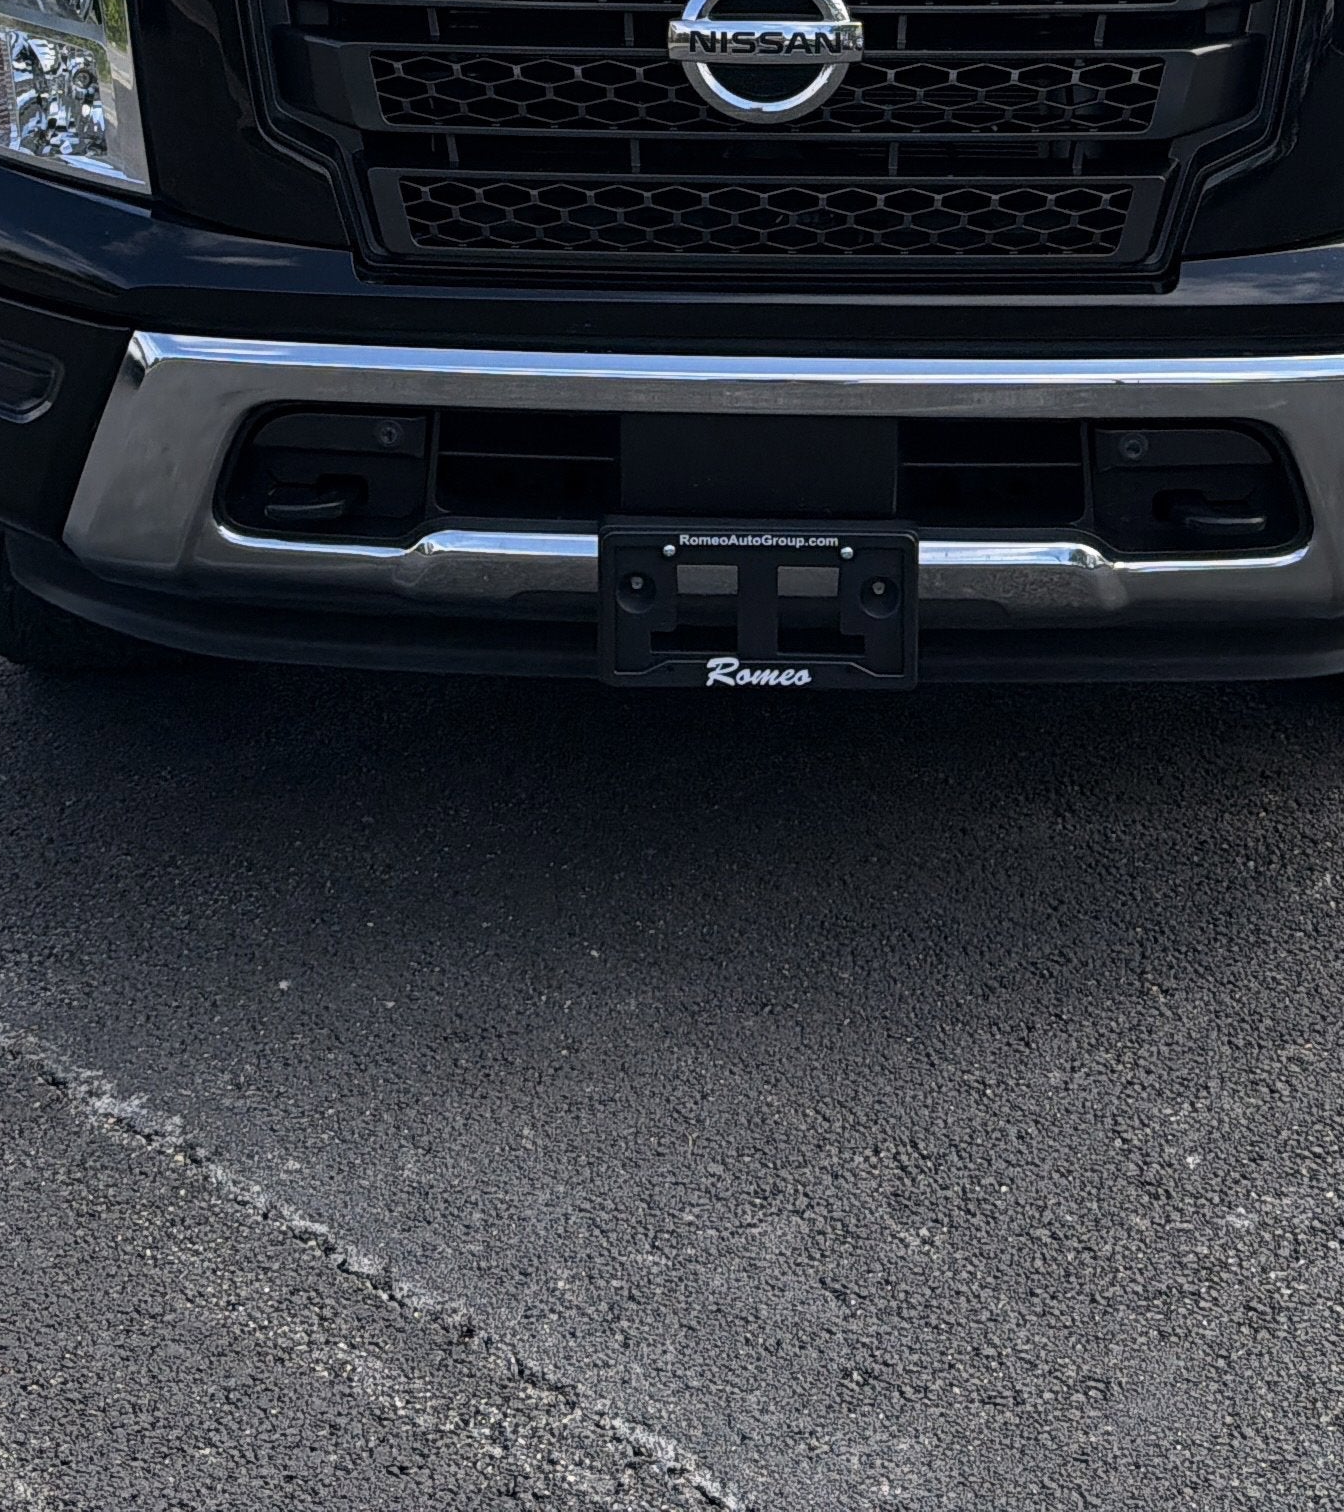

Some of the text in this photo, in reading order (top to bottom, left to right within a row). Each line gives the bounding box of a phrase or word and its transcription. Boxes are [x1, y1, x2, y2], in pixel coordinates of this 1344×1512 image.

[689, 31, 842, 54] NISSAN
[679, 534, 839, 548] RomeoAutoGroup.com
[705, 656, 812, 687] Romeo
